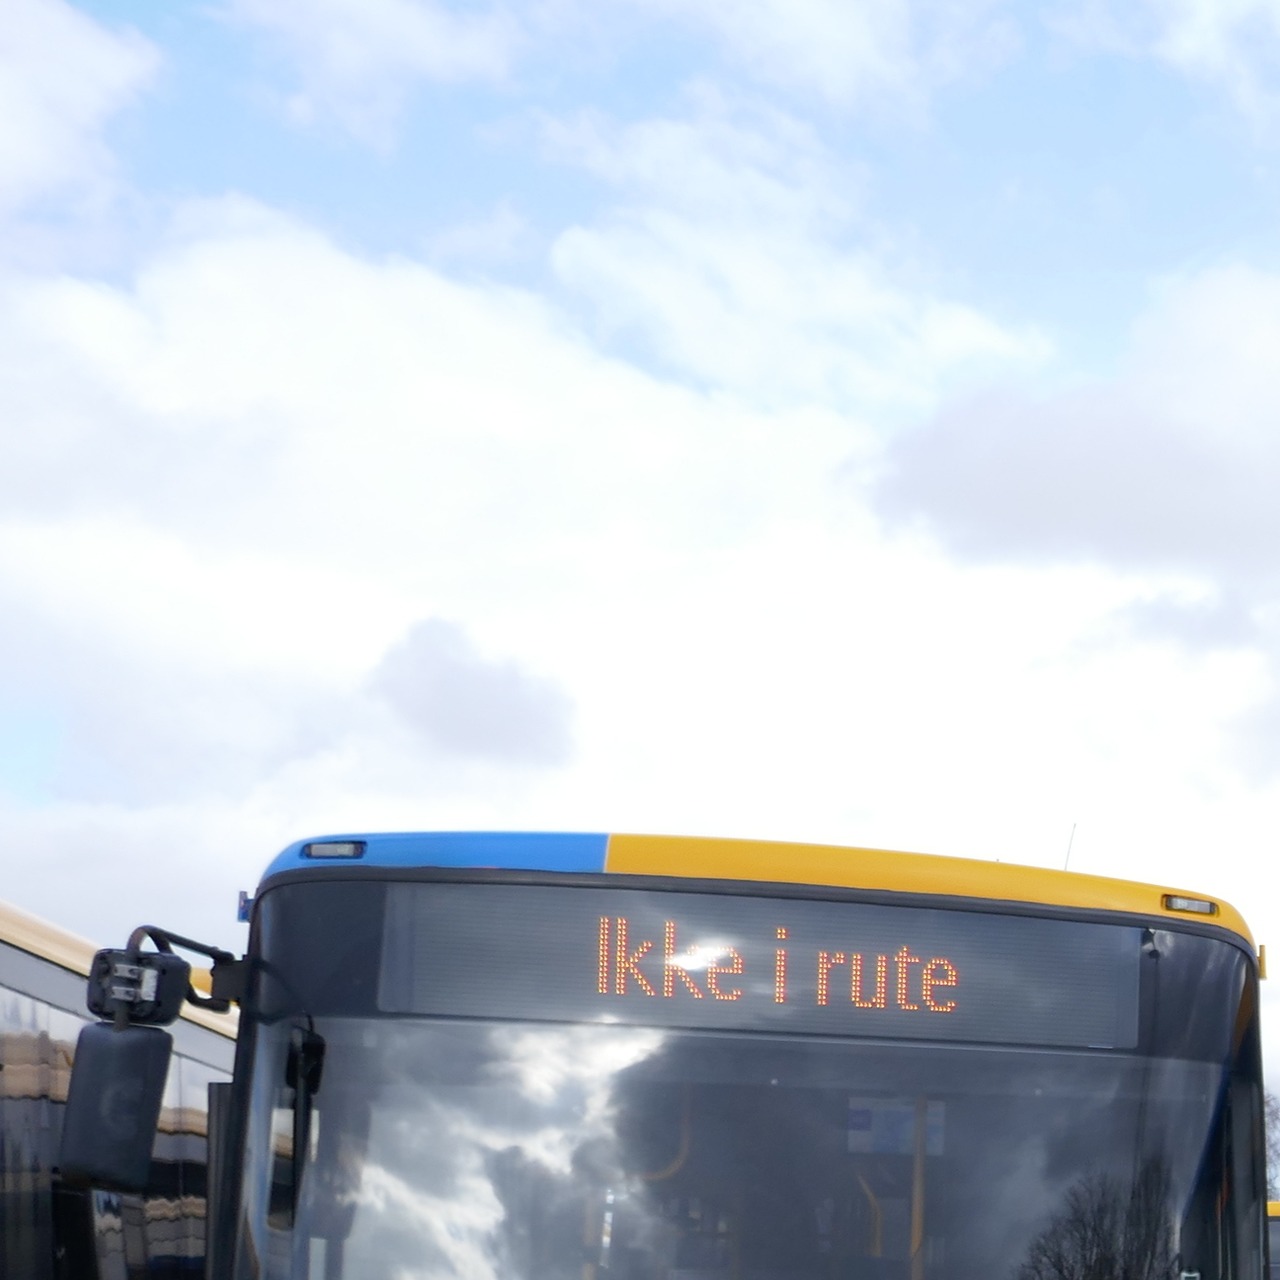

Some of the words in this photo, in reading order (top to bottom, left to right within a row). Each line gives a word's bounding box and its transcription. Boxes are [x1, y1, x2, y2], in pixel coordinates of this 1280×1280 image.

[598, 916, 743, 1001] Ikke
[775, 927, 788, 1003] i
[817, 945, 957, 1012] rute
